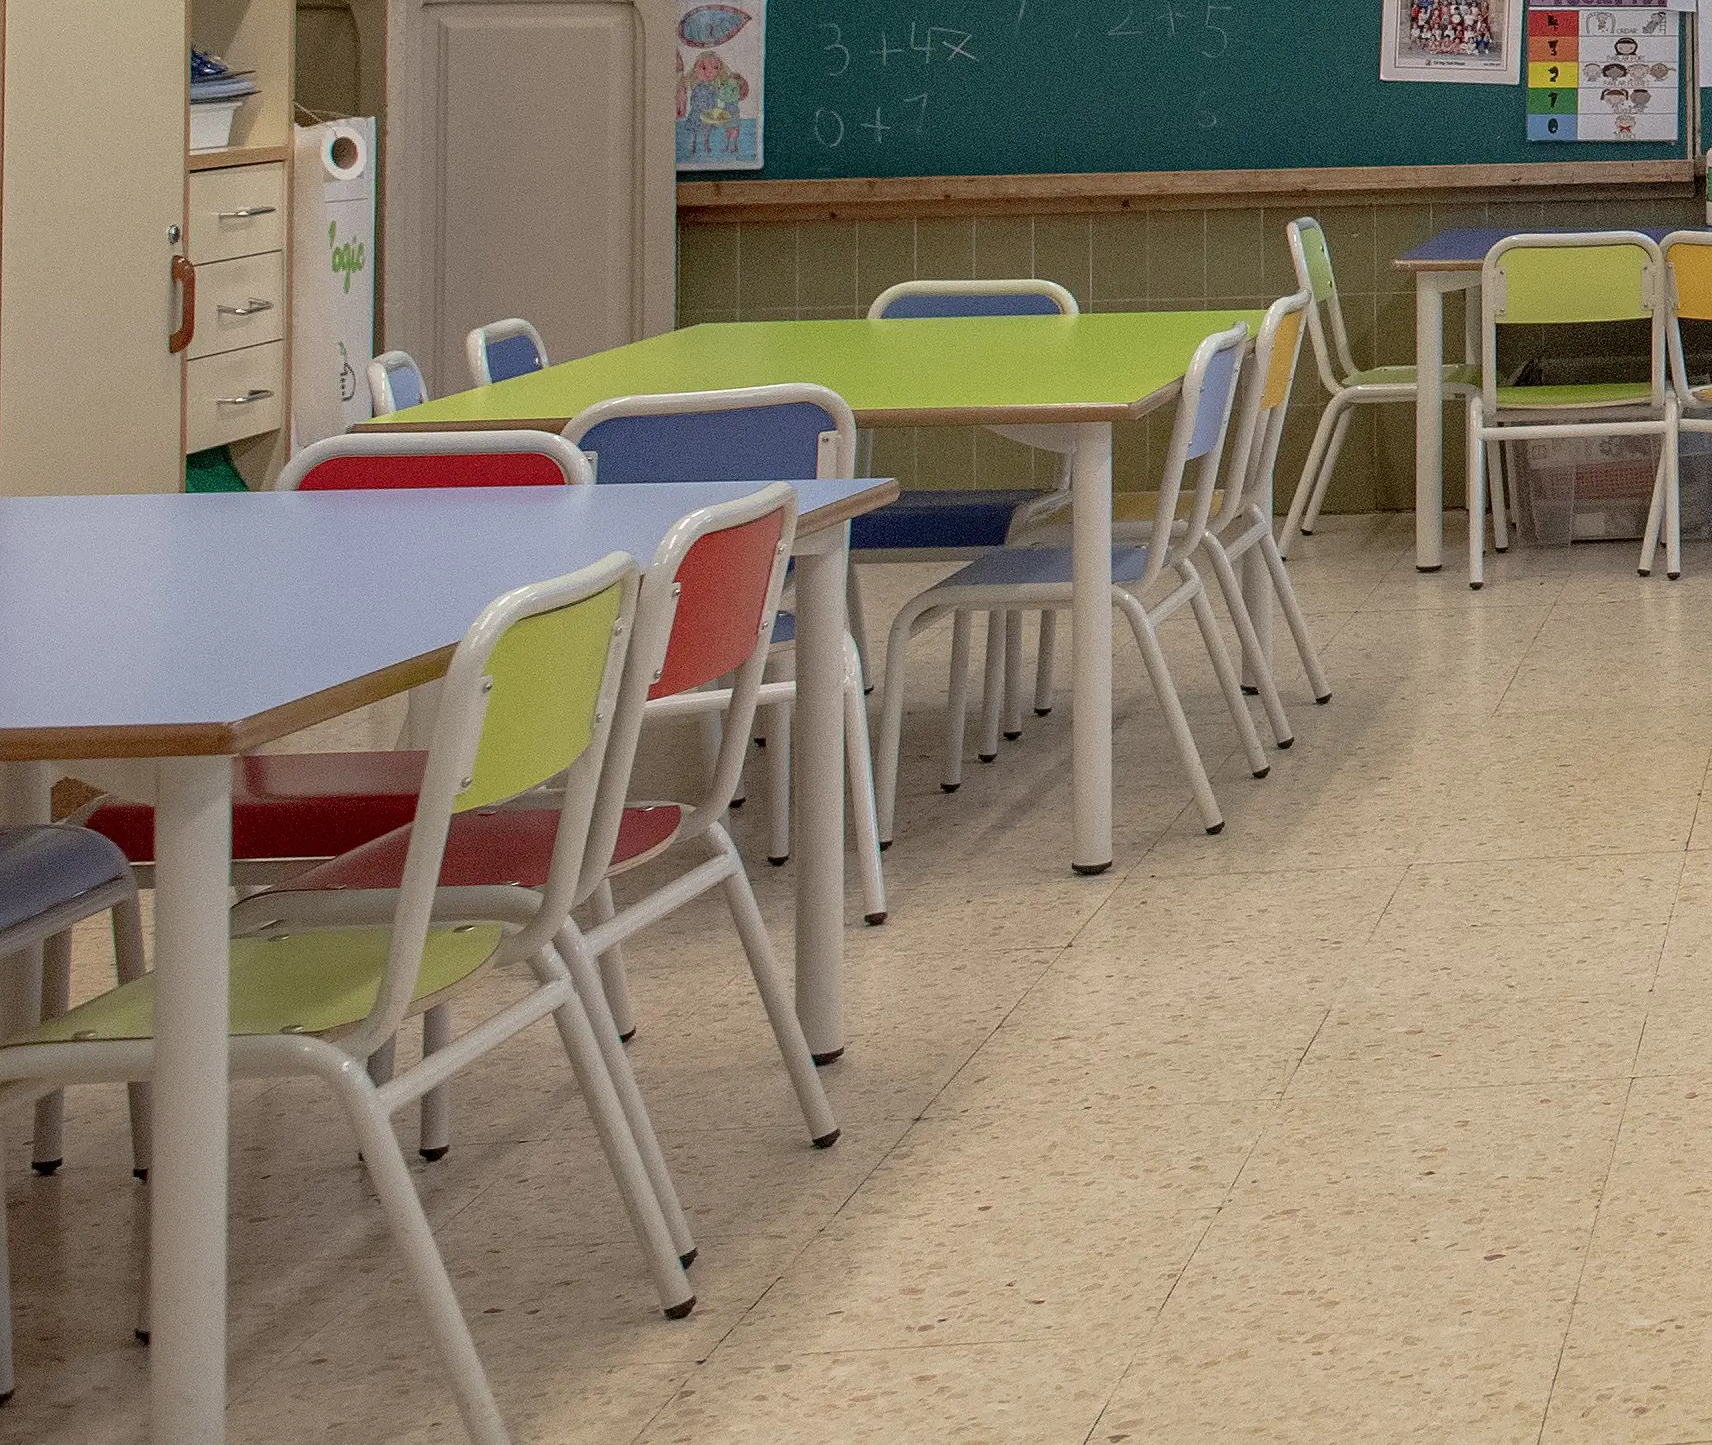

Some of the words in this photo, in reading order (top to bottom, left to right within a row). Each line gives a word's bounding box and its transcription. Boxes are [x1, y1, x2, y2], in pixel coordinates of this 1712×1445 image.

[1548, 39, 1558, 56] 3
[1548, 65, 1559, 83] 2
[1548, 91, 1559, 108] 1
[1547, 117, 1558, 134] 0
